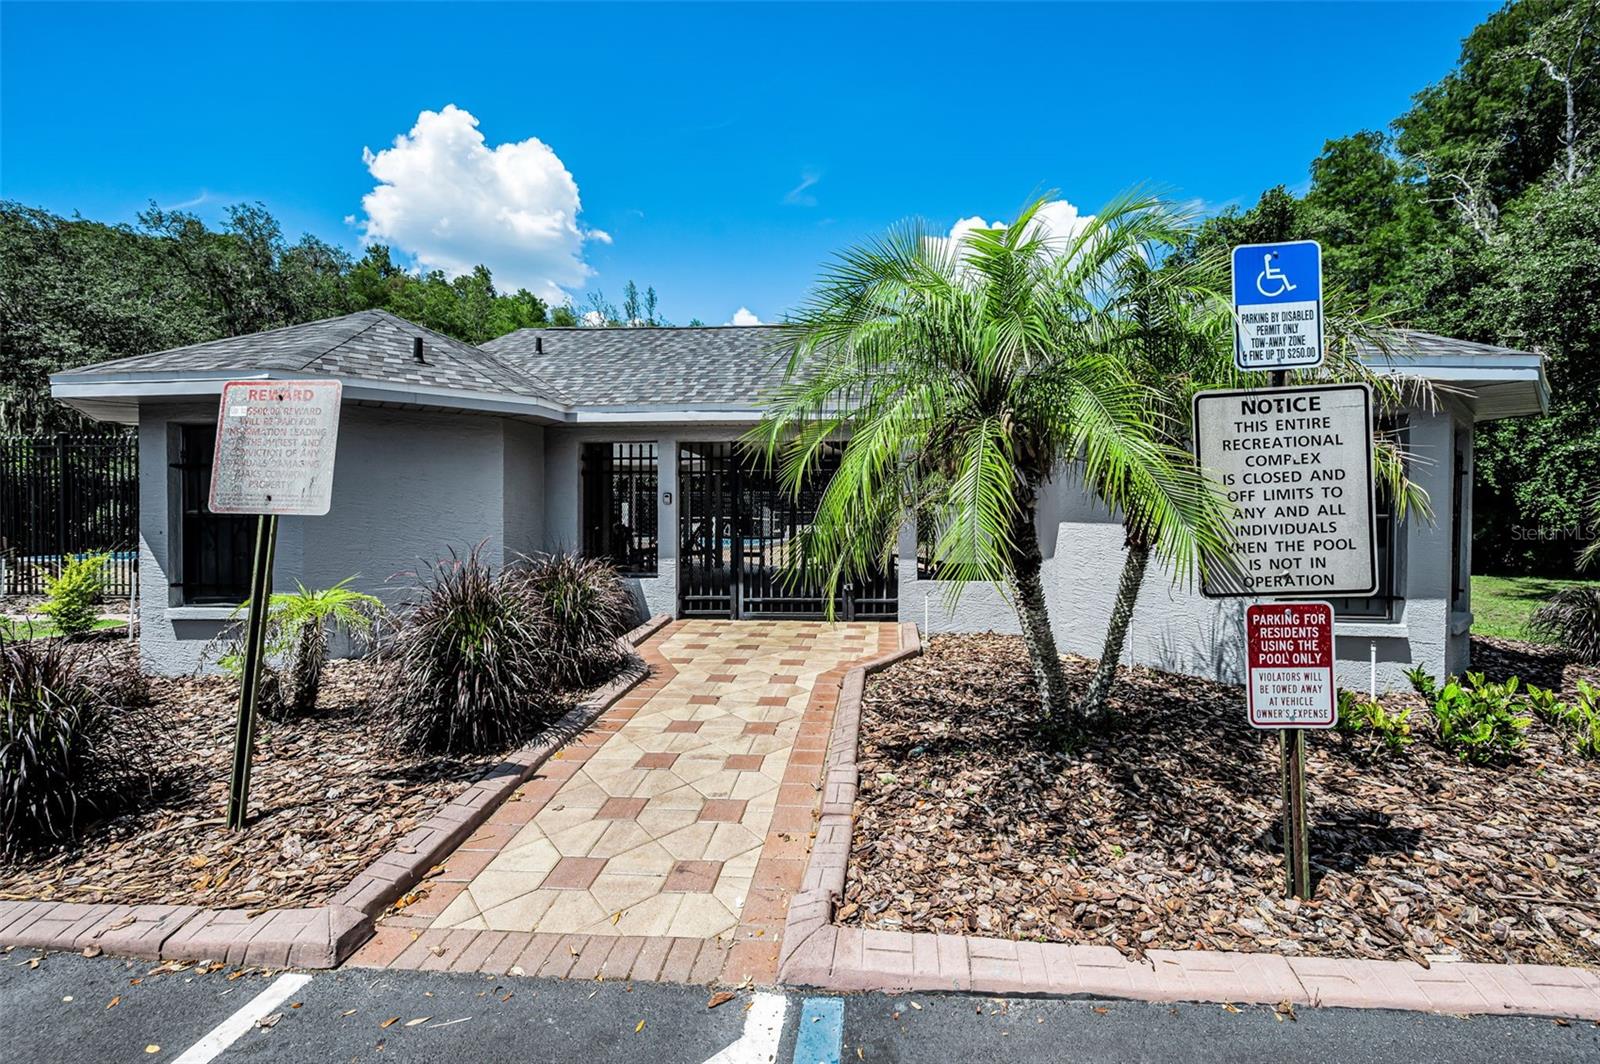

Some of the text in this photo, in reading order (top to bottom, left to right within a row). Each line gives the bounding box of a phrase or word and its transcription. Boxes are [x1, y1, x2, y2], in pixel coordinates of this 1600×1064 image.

[1242, 310, 1314, 324] PARKING BY DISABLED
[1256, 324, 1299, 335] PERMIT ONLY
[1251, 335, 1306, 348] TOW-AWAY ZONE
[1243, 347, 1315, 360] & FINE UP TO $250.00
[248, 389, 314, 401] REWARD
[284, 407, 322, 416] REWARD
[1241, 396, 1321, 415] NOTICE
[1234, 417, 1330, 433] THIS ENTIRE
[301, 438, 321, 448] AND
[1223, 434, 1343, 451] RECREATIONAL
[285, 449, 298, 458] OF
[1245, 452, 1321, 467] COMPLEX
[1223, 469, 1345, 485] IS CLOSED AND
[1227, 487, 1343, 502] OFF LIMITS TO
[1233, 504, 1346, 519] ANY AND ALL
[1235, 522, 1337, 536] INDIVIDUALS
[1275, 540, 1305, 552] THE
[1314, 538, 1357, 550] POOL
[1250, 557, 1326, 570] IS NOT IN
[1243, 574, 1334, 588] OPERATION
[1253, 614, 1326, 625] PARKING FOR
[1260, 627, 1319, 638] RESIDENTS
[1261, 640, 1319, 651] USING THE
[1259, 653, 1322, 664] POOL ONLY
[1259, 672, 1322, 681] VIOLATORS WILL
[1260, 684, 1323, 694] BE TOWED AWAY
[1269, 697, 1313, 706] AT VEHICLE
[1257, 709, 1328, 718] OWNER'S EXPENSE
